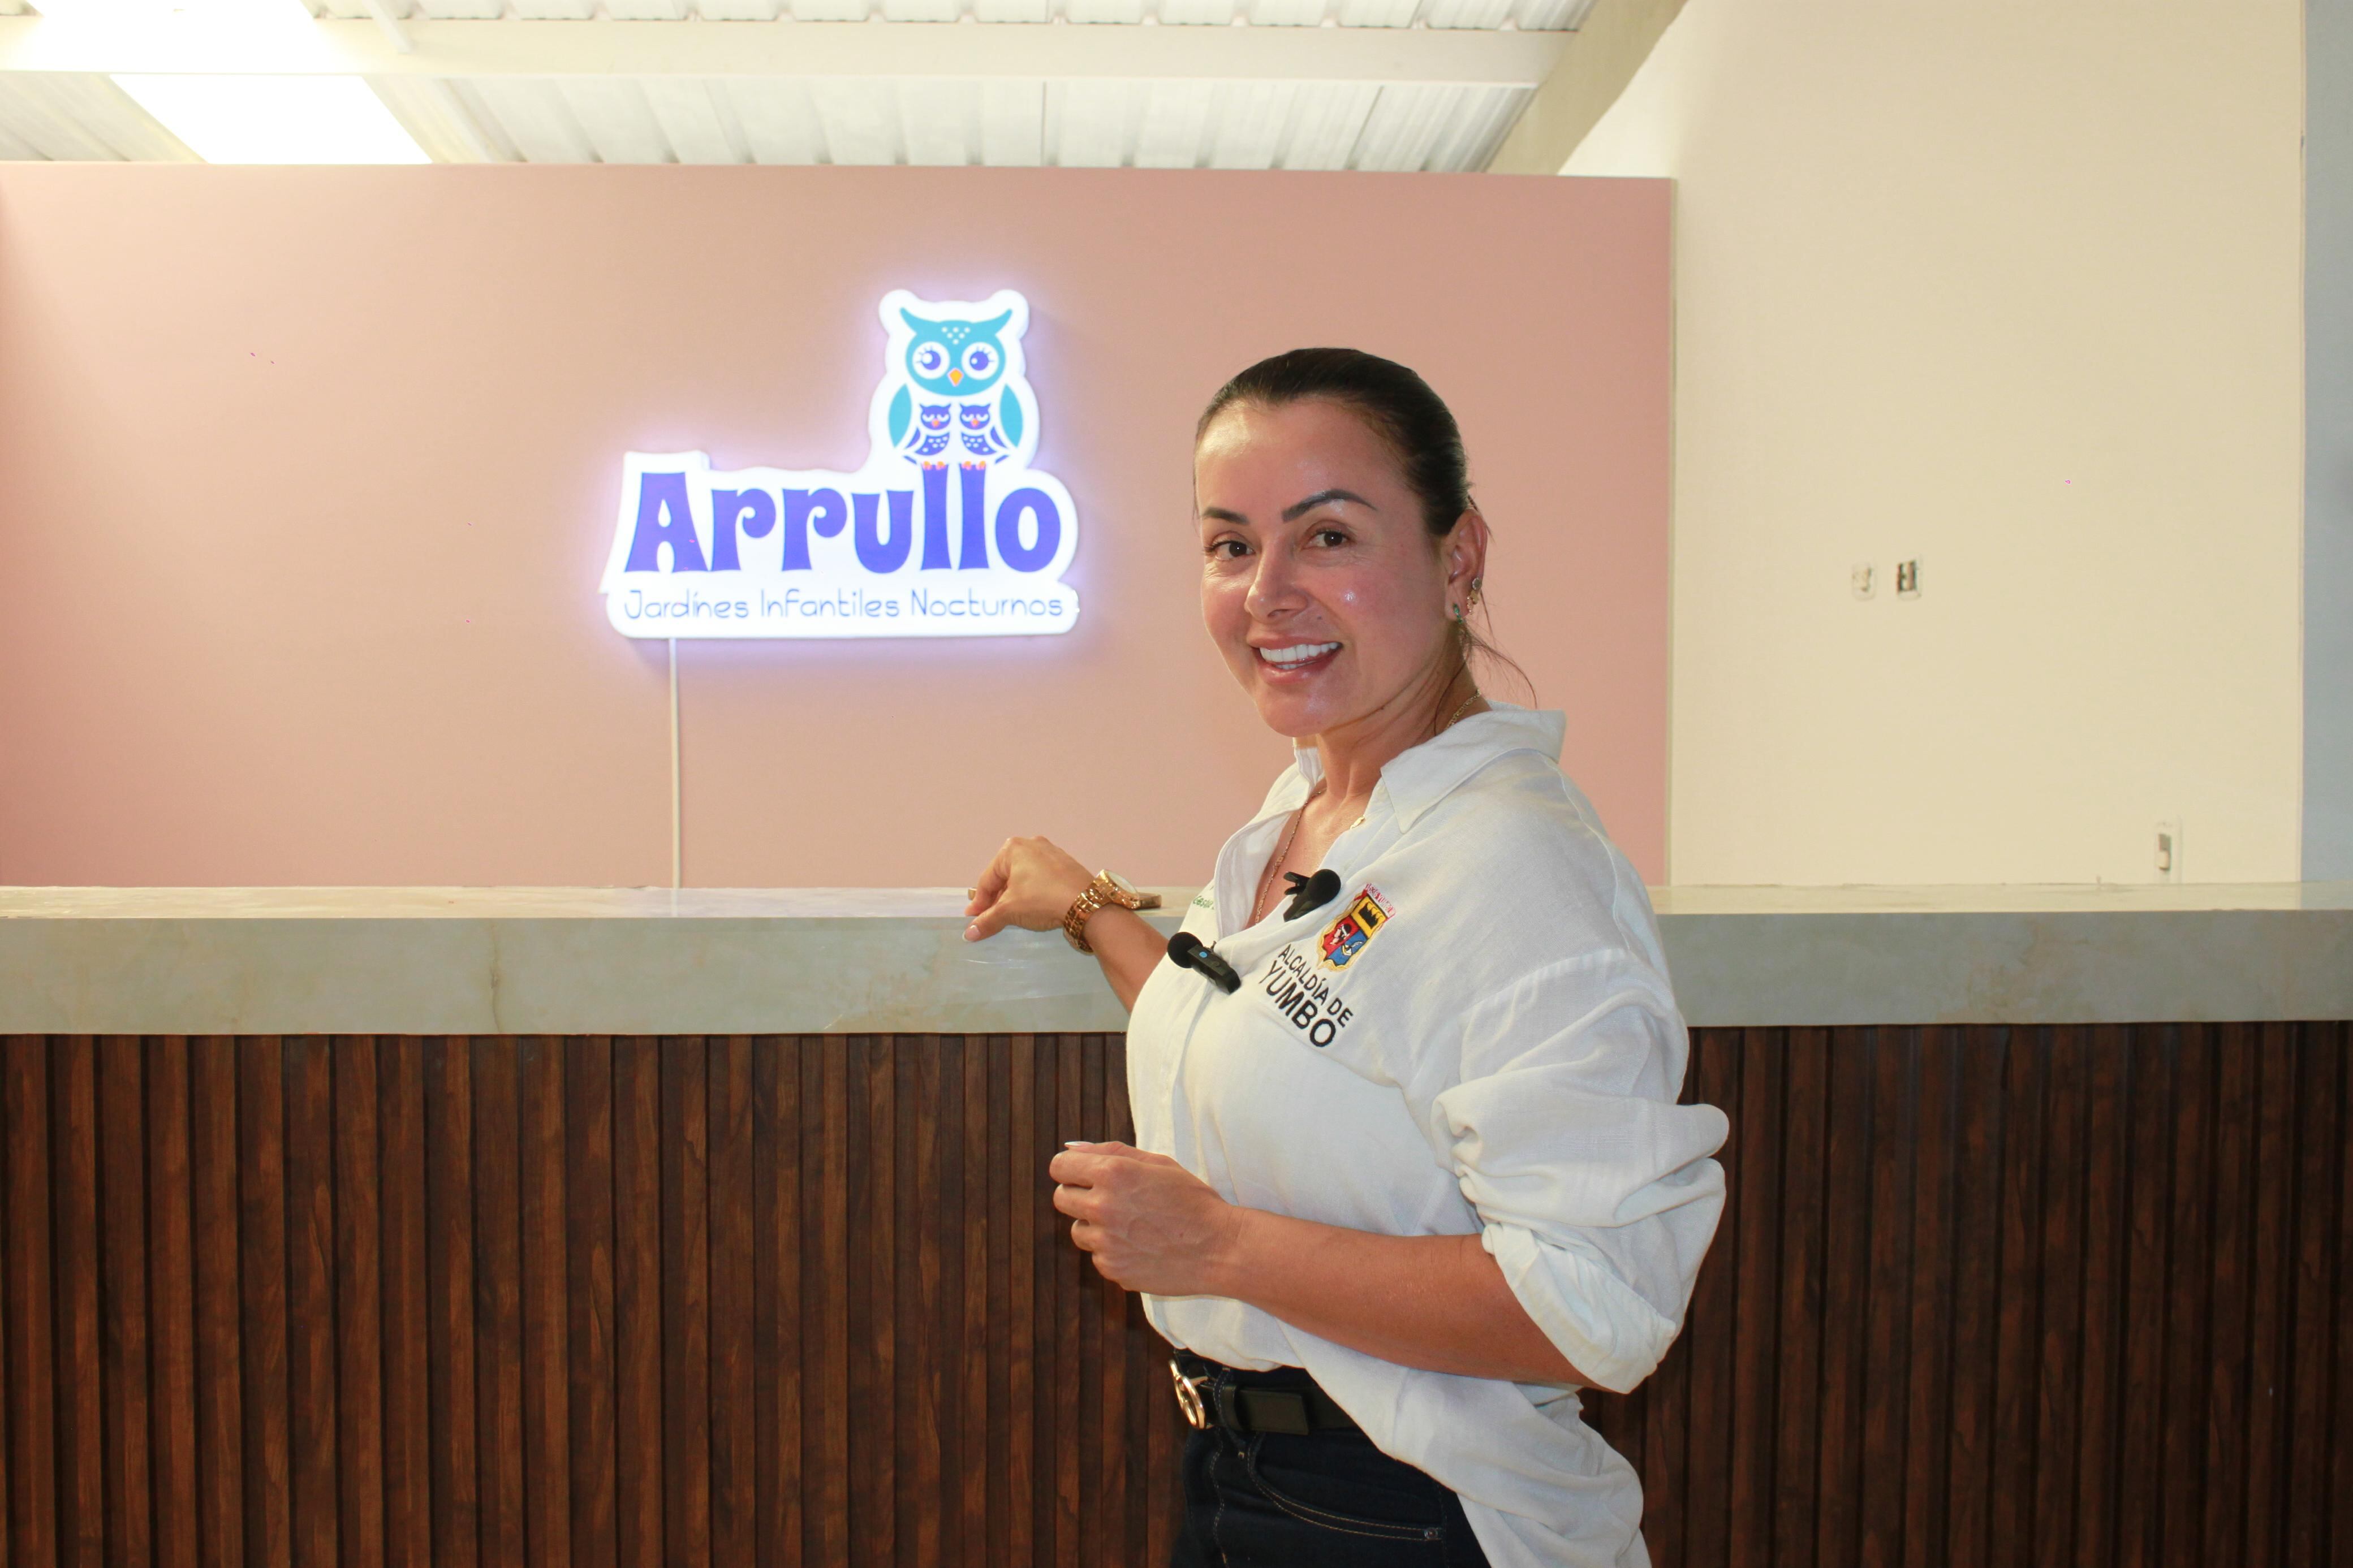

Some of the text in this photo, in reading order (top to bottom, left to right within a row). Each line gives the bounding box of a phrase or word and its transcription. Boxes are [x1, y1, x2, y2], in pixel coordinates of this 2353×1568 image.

[624, 463, 1061, 574] Arrullo
[761, 588, 900, 617] Infantiles
[911, 588, 1063, 617] Nocturnos
[1258, 960, 1337, 1048] YUMBO
[1277, 943, 1354, 1027] ALCALDÍA DE
